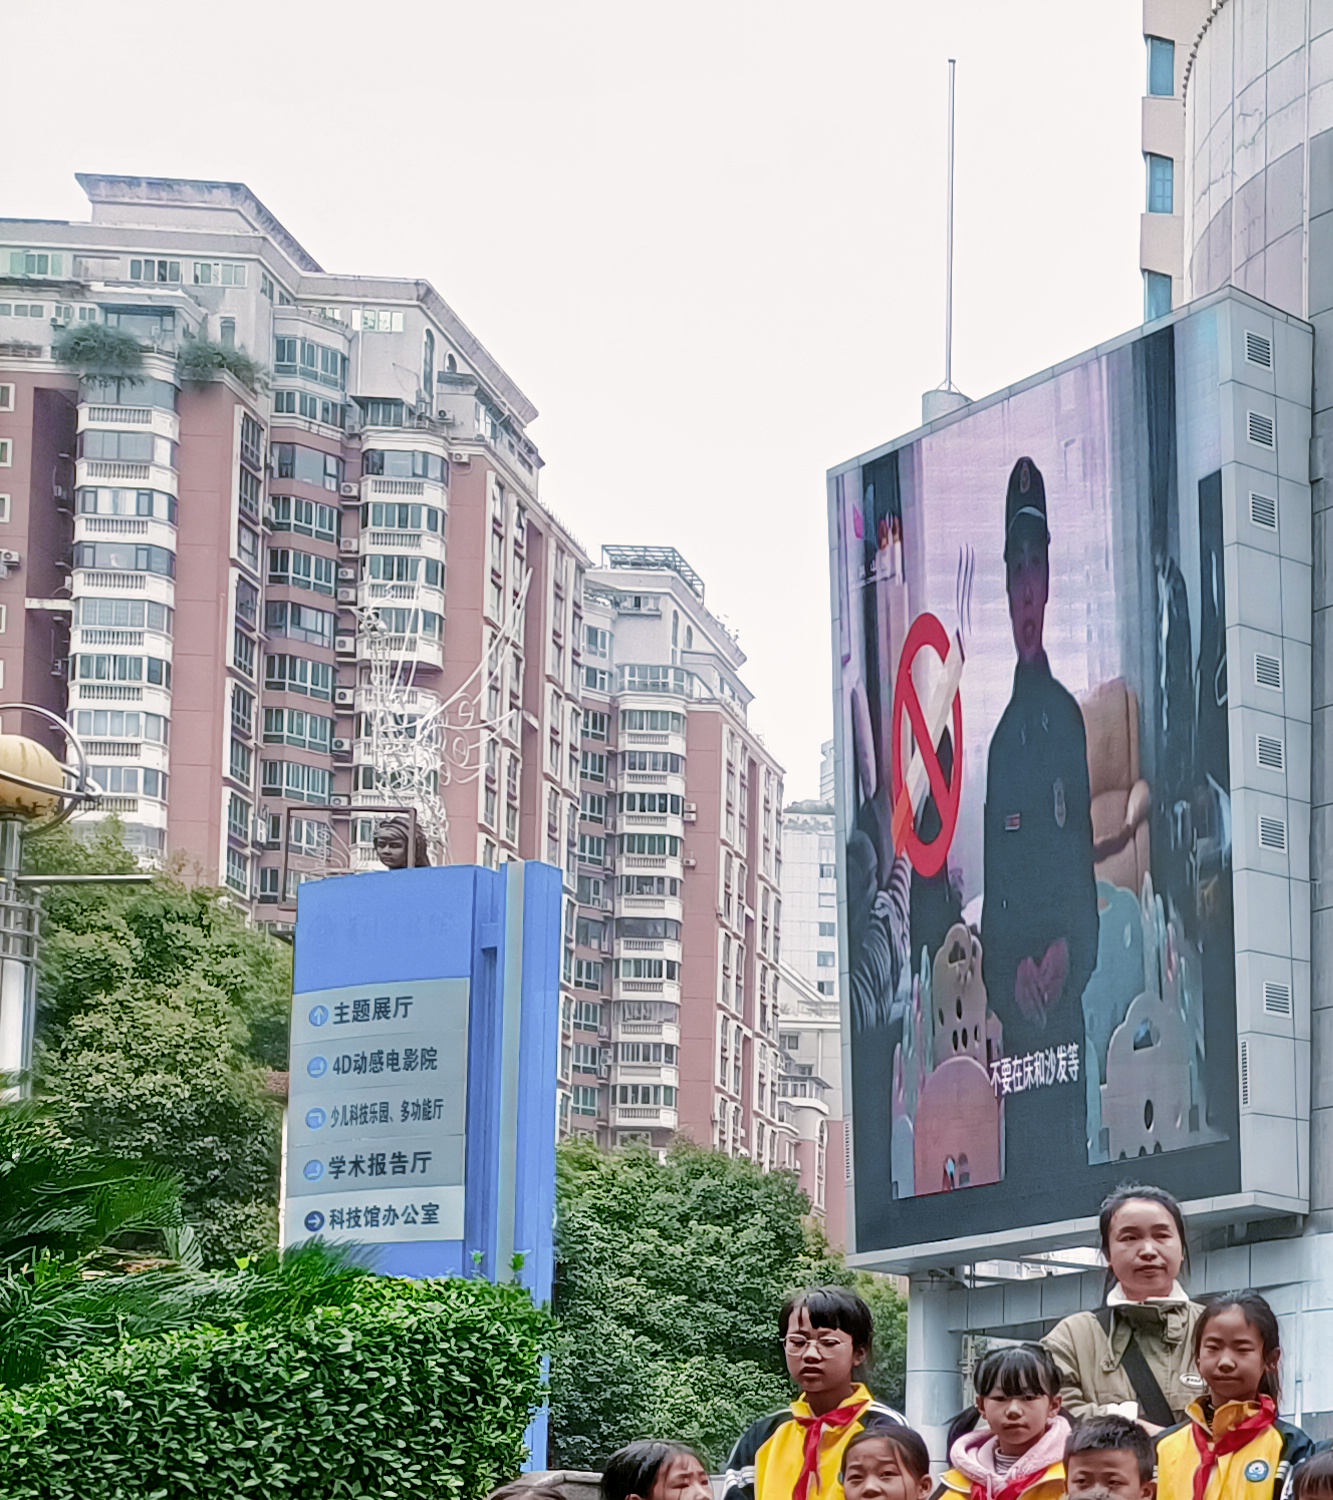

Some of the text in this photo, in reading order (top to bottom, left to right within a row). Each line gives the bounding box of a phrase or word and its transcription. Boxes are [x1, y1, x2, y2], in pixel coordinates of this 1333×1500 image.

[333, 995, 414, 1026] 主题展厅
[332, 1046, 438, 1076] 4D动感电影院
[989, 1042, 1080, 1097] 不要在床和沙发等
[330, 1098, 445, 1128] 少儿科技乐园、多功能厅
[328, 1151, 433, 1180] 学术报告厅
[328, 1202, 440, 1230] 科技馆办公室
